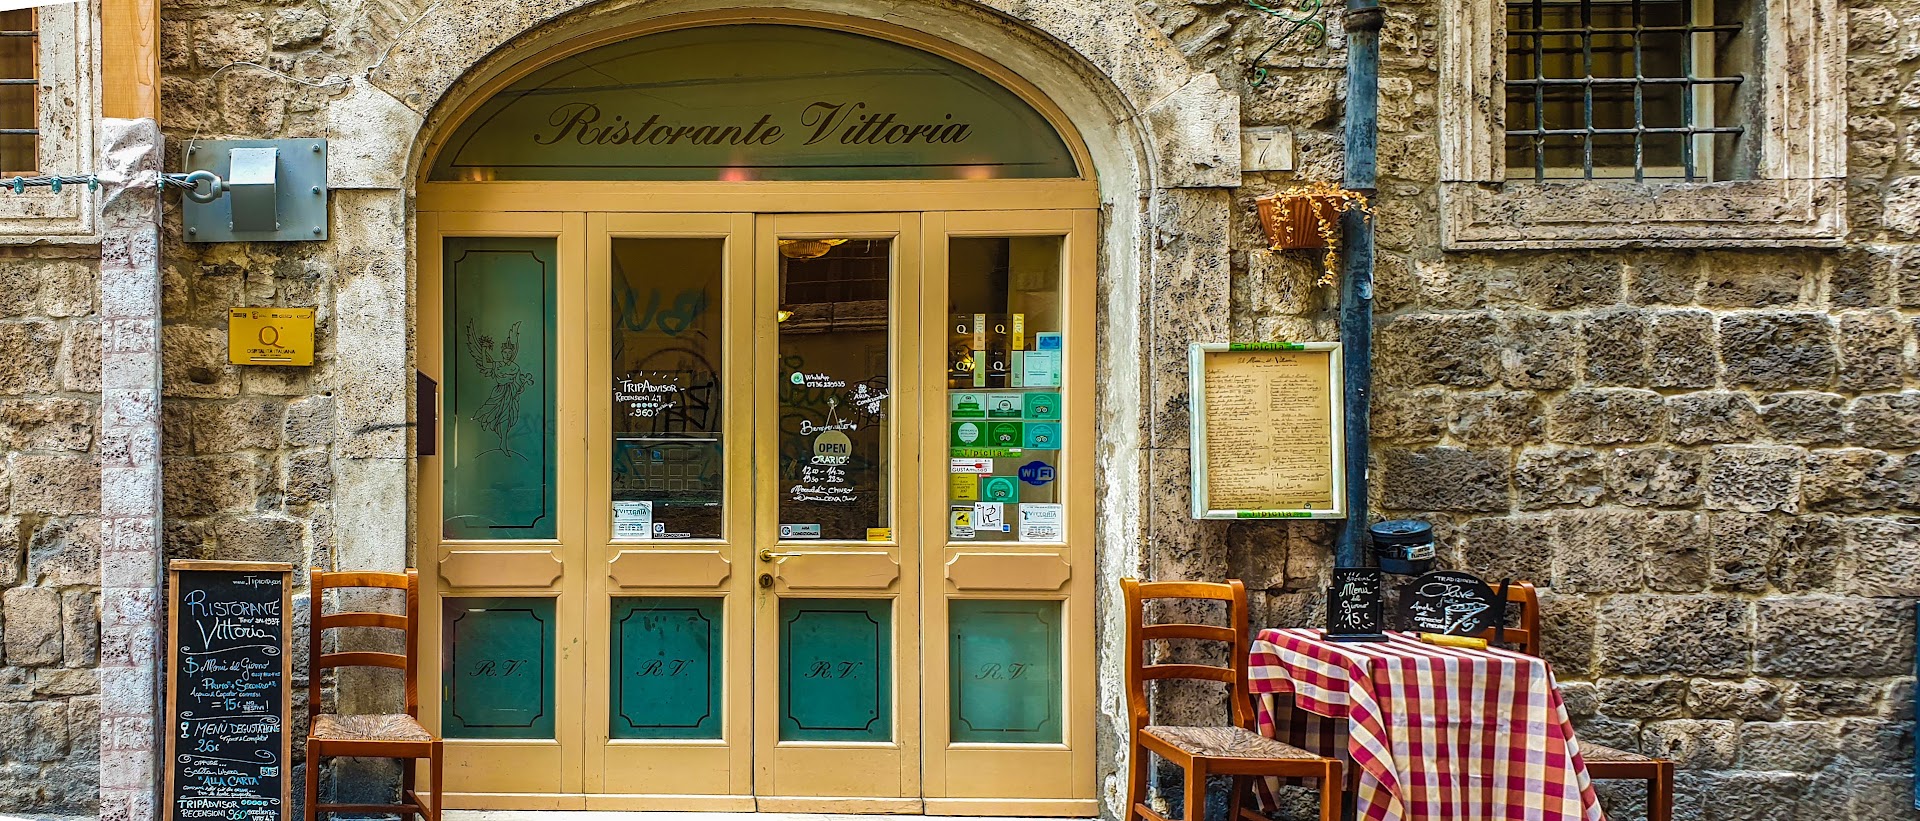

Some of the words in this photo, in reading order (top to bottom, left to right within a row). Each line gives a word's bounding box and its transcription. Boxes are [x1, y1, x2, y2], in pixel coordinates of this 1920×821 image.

[534, 102, 784, 146] Ristorante
[800, 101, 973, 146] Vittoria
[1257, 137, 1272, 164] 7
[818, 443, 847, 453] OPEN
[183, 589, 280, 617] RISTORANTE
[196, 616, 277, 650] Vittoria
